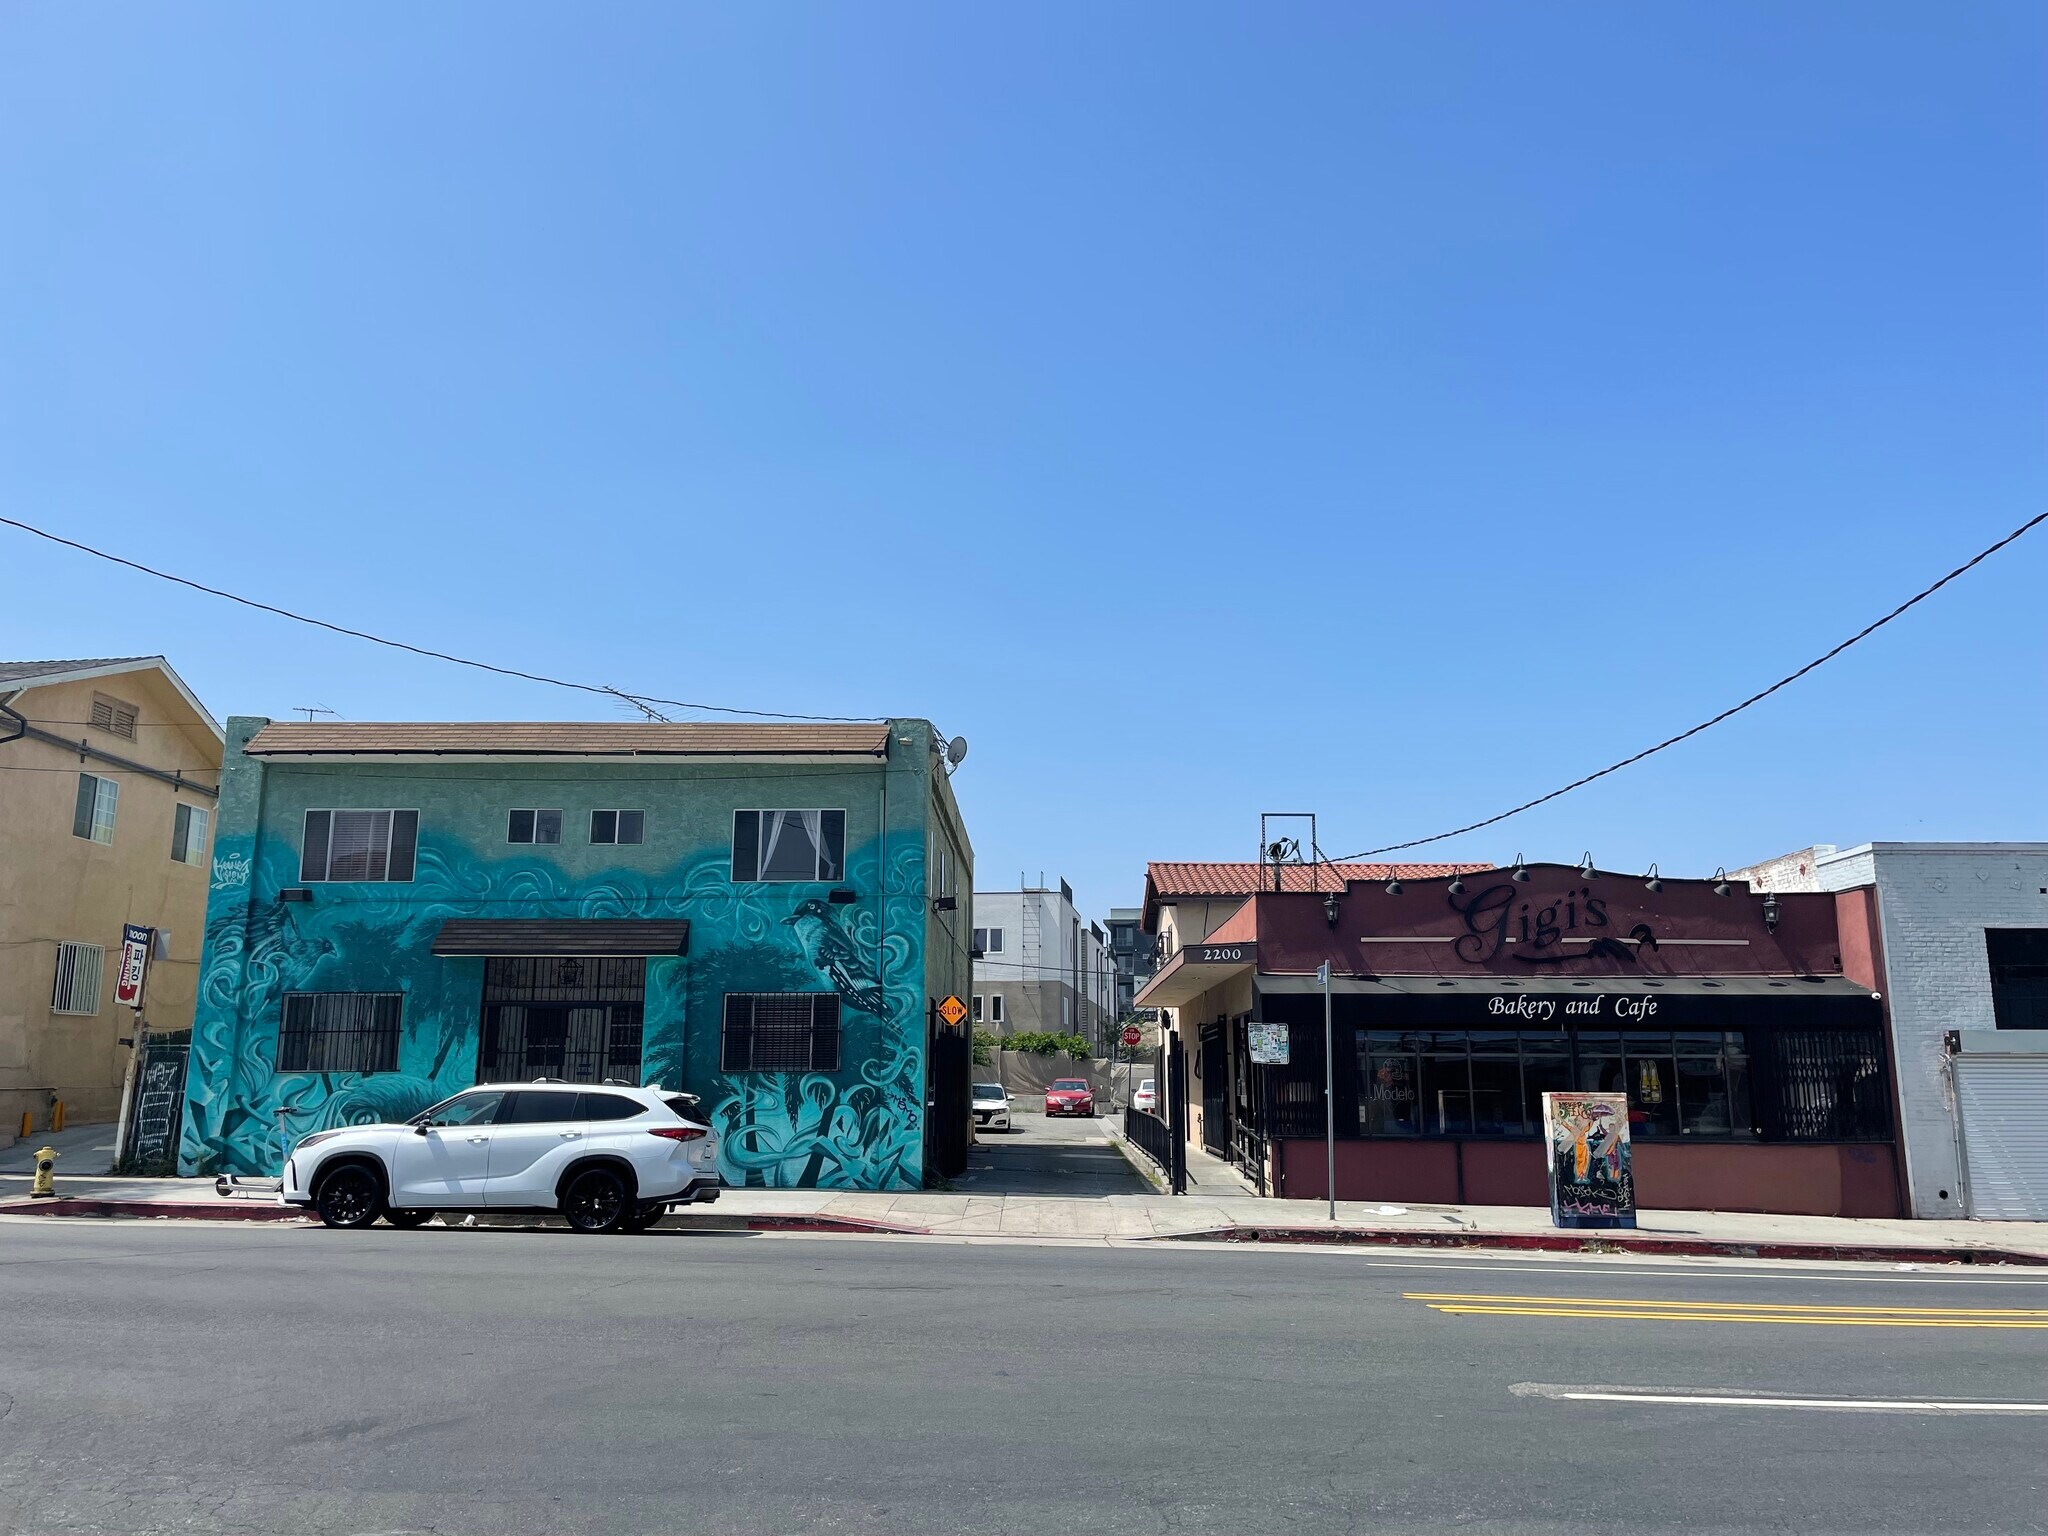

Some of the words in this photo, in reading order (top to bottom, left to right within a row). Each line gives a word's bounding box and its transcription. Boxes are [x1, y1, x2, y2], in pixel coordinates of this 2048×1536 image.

[1447, 884, 1609, 964] Gigi's
[1203, 948, 1242, 961] 2200
[131, 948, 144, 981] 파킹
[942, 1006, 964, 1016] SLOW
[1487, 994, 1556, 1021] Bakery
[1565, 994, 1605, 1015] and
[1614, 994, 1658, 1022] Cafe
[1123, 1032, 1141, 1041] STOP
[1372, 1083, 1415, 1102] Modelo
